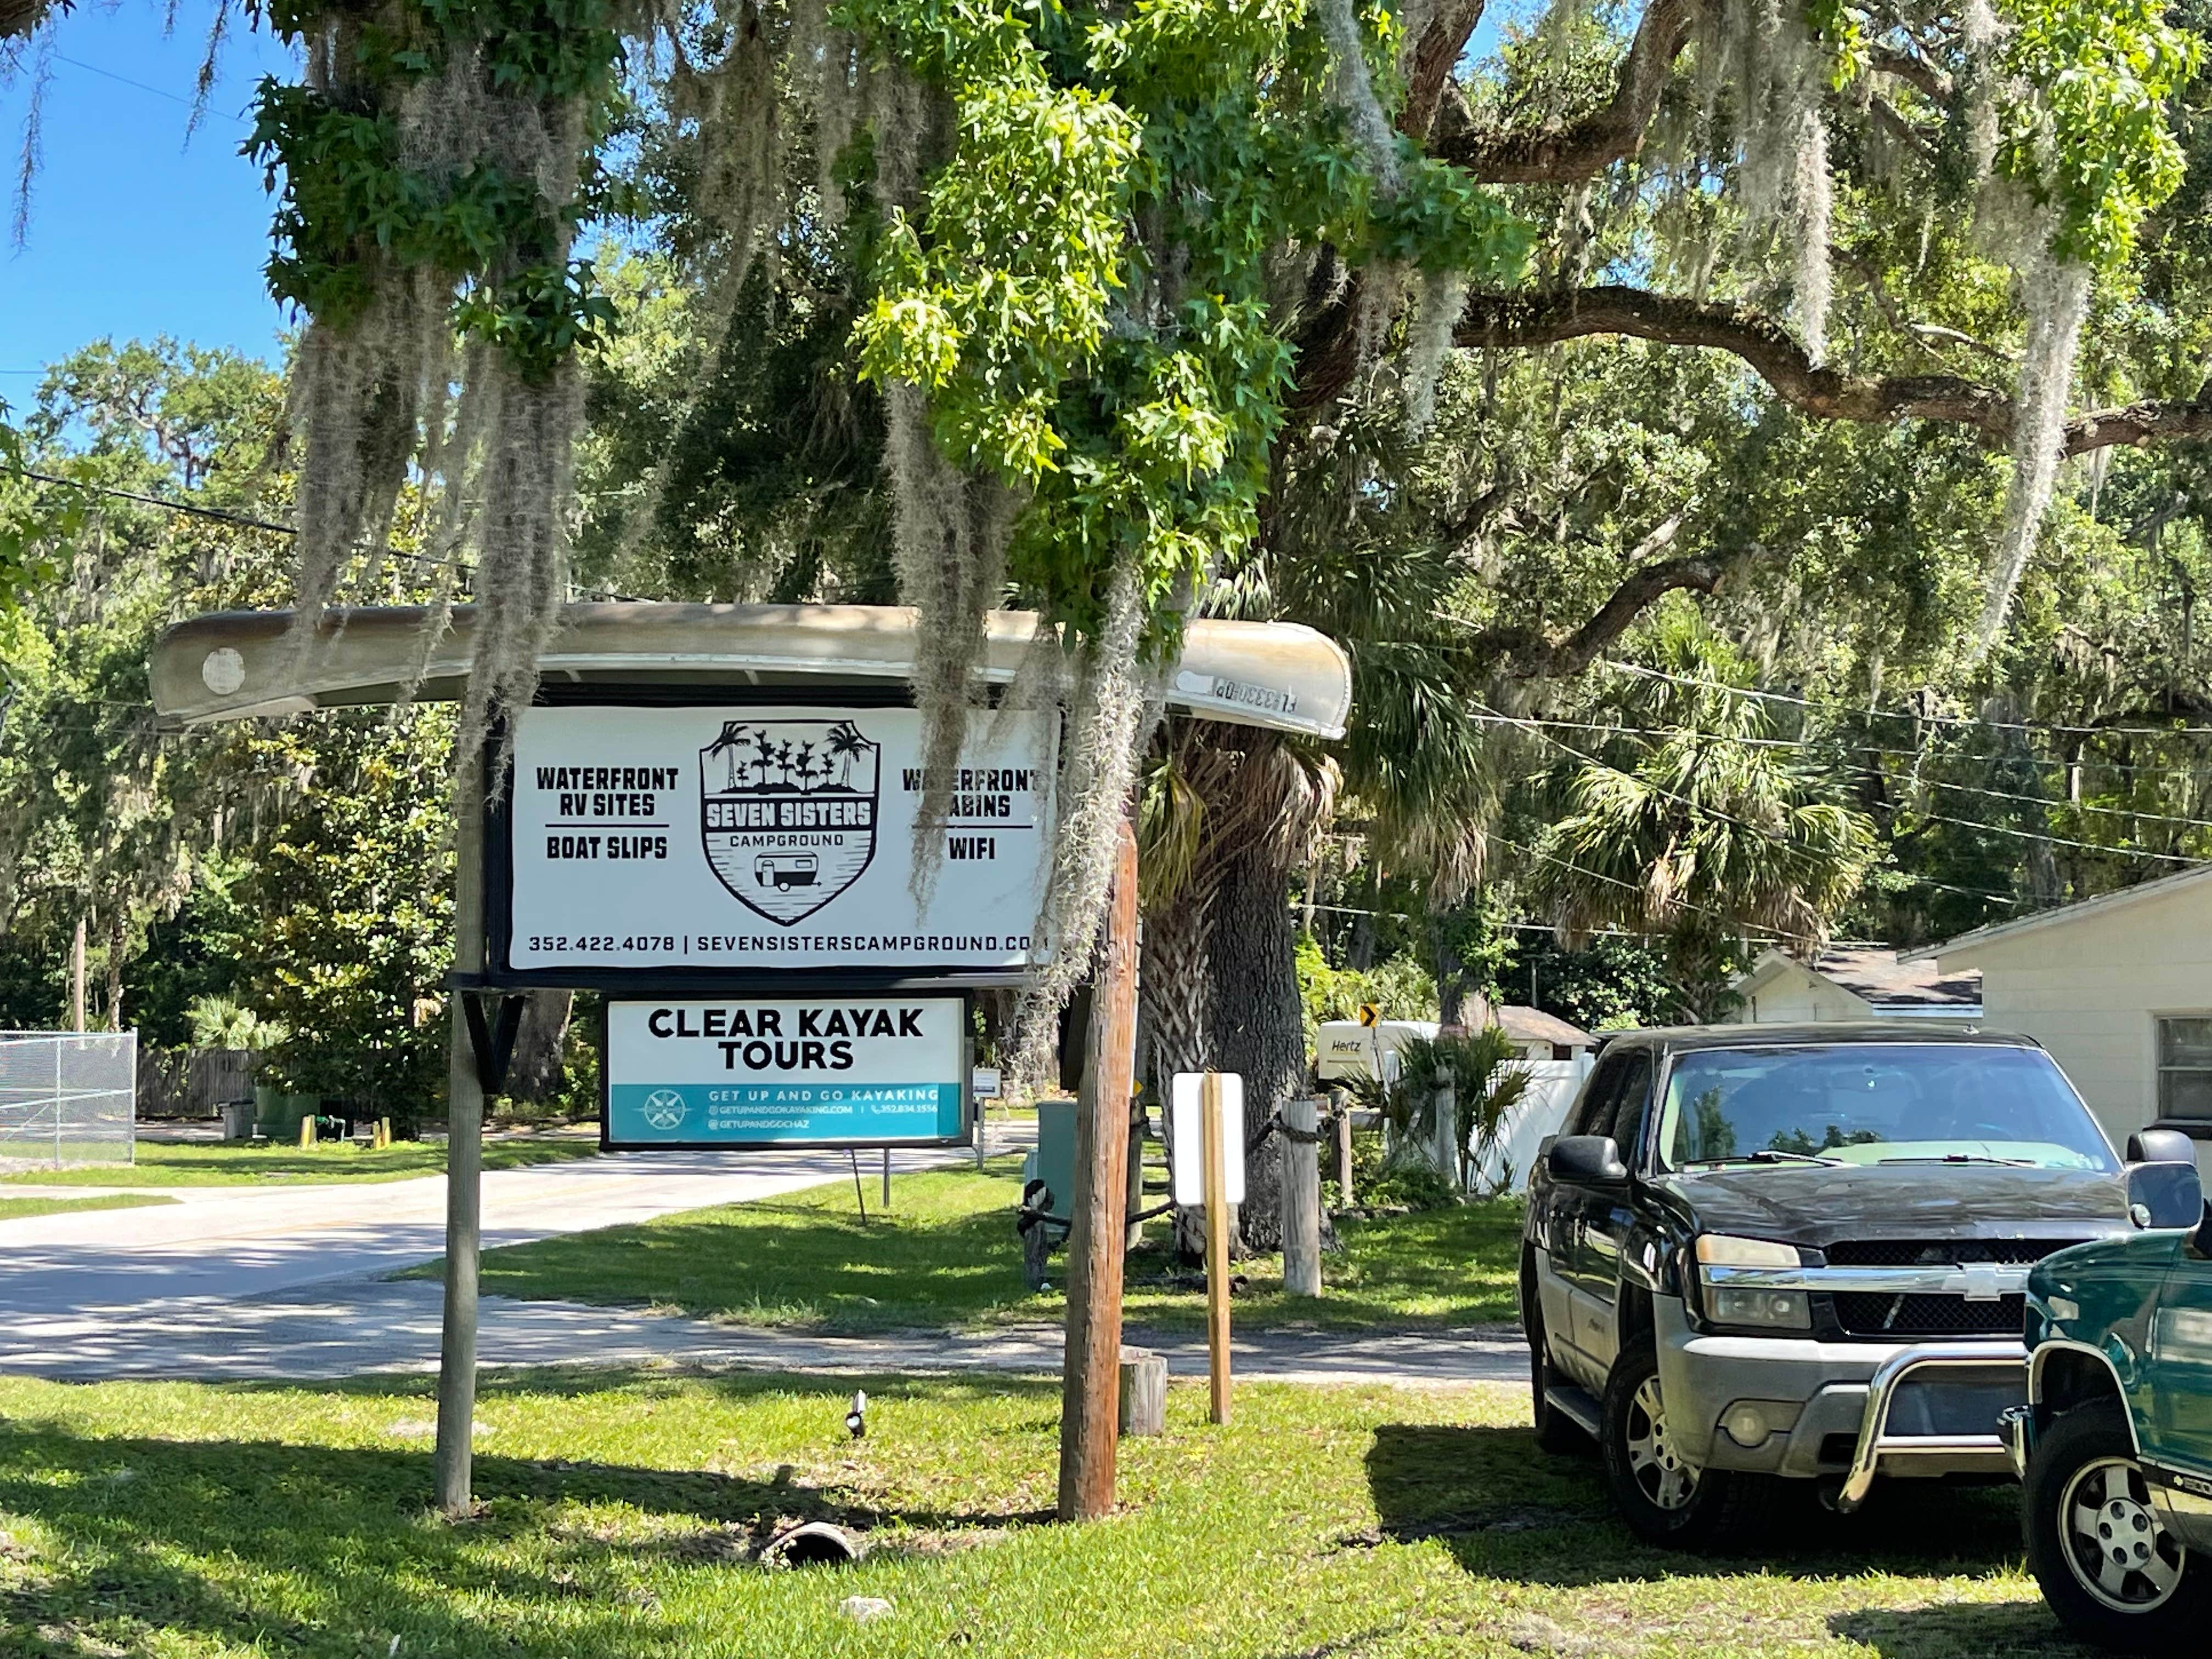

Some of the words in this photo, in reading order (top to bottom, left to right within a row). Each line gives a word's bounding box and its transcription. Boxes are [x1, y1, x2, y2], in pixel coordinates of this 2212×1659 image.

[537, 767, 679, 790] WATERFRONT
[903, 769, 1039, 791] WRFRON
[560, 793, 587, 816] RV
[593, 793, 654, 816] SITES
[706, 803, 776, 827] SEVEN
[780, 802, 871, 827] SISTERS
[949, 795, 1011, 817] ABINS
[547, 836, 601, 859] BOAT
[607, 836, 667, 859] SLIPS
[730, 834, 844, 847] CAMPGROUND
[949, 837, 995, 860] WIFI
[528, 936, 674, 952] 352.422.4078
[648, 1008, 783, 1039] CLEAR
[798, 1008, 924, 1037] KAYAK
[717, 1040, 854, 1070] TOURS
[1331, 1040, 1361, 1052] Hertz
[708, 1090, 740, 1101] GET
[748, 1090, 769, 1101] UP
[776, 1090, 811, 1101] AND
[820, 1090, 843, 1101] GO
[851, 1089, 938, 1101] KAYAKING
